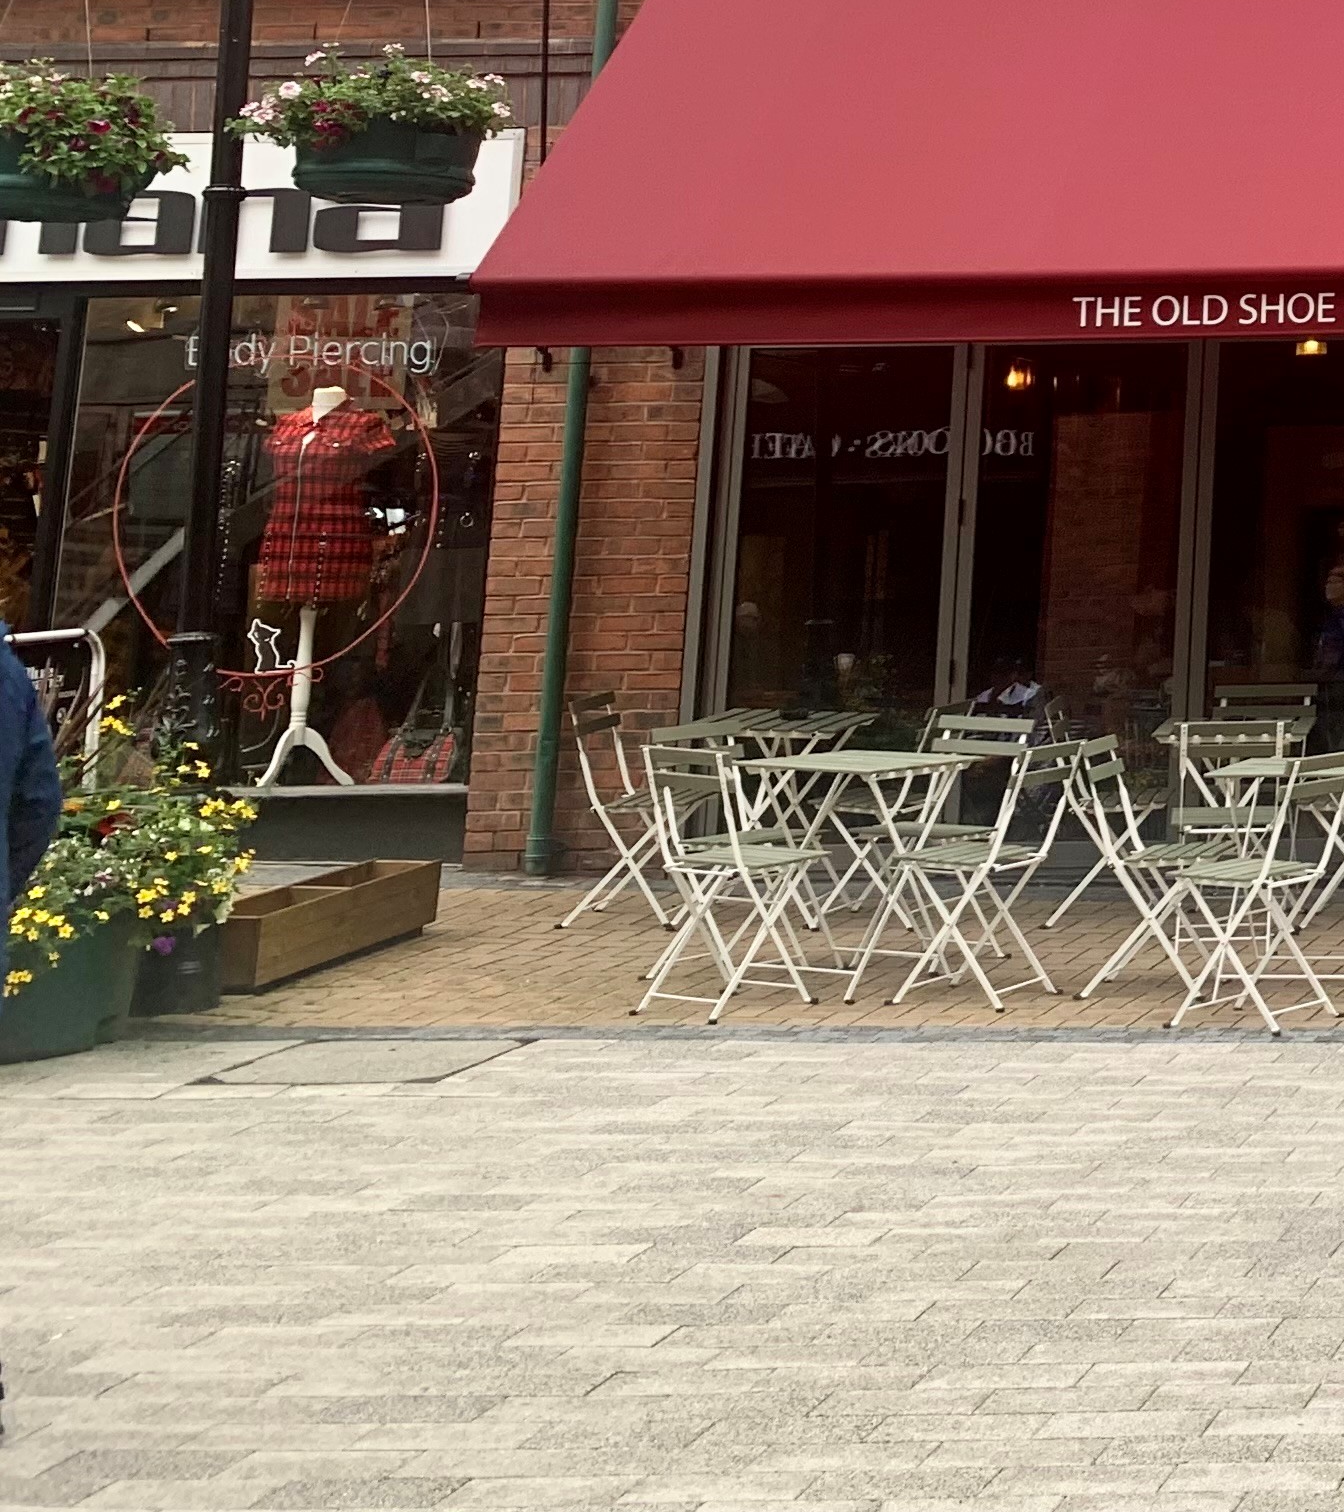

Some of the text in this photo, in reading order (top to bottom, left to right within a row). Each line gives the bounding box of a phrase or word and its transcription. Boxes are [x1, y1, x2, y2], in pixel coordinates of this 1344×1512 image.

[1072, 292, 1337, 328] THE OLD SHOE
[289, 332, 433, 374] Piercing
